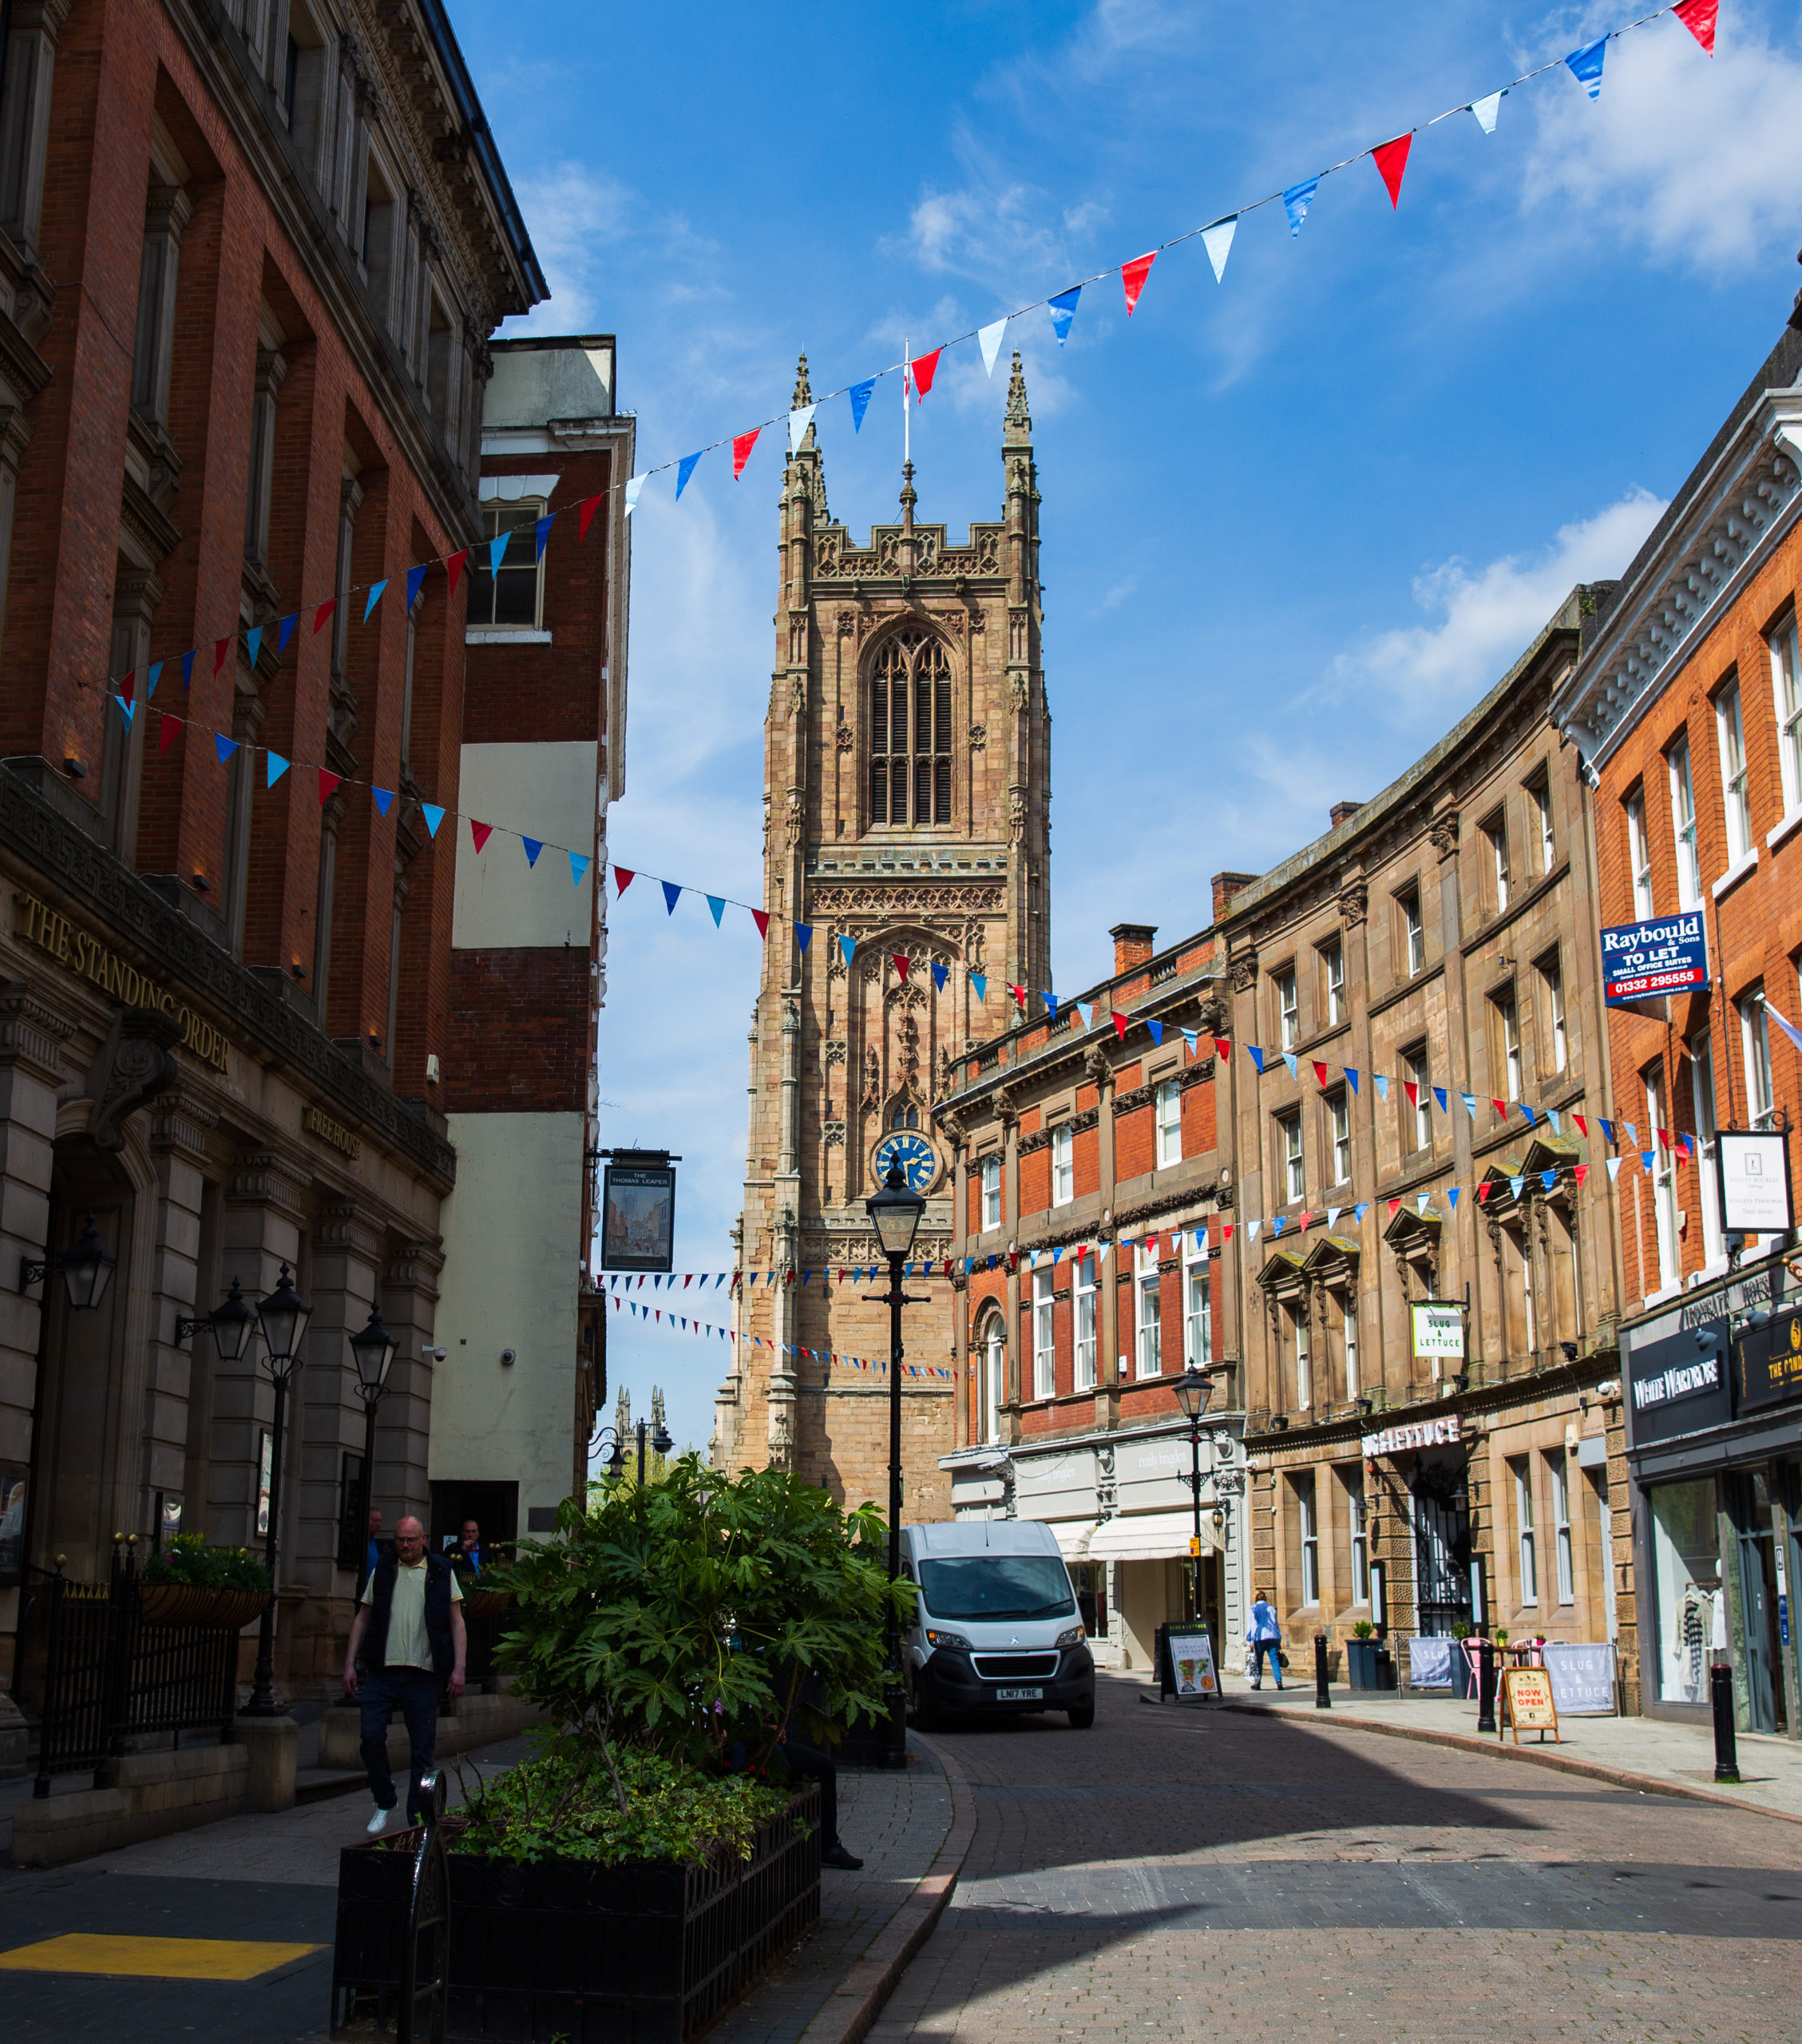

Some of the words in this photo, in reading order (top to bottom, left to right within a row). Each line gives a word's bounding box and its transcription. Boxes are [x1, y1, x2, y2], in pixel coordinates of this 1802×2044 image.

[1603, 917, 1700, 952] Raybould
[1678, 936, 1701, 945] Sons
[1622, 953, 1645, 966] TO
[1649, 946, 1679, 961] LET
[1612, 967, 1636, 976] SMALL
[1637, 961, 1663, 972] OFFICE
[1665, 957, 1693, 967] SUITES
[26, 893, 71, 962] THE
[178, 1006, 230, 1075] ORDER
[1615, 979, 1647, 993] 01332
[1650, 971, 1694, 988] 295555
[311, 1107, 332, 1143] FREE
[1428, 1319, 1450, 1328] SLUG
[1420, 1337, 1459, 1347] LETTUCE
[1768, 1361, 1783, 1380] THE
[1634, 1377, 1665, 1409] WHITE
[1663, 1359, 1718, 1400] WARDROBE
[1388, 1419, 1460, 1452] LETTUCE
[1139, 1452, 1157, 1470] emily
[1158, 1448, 1186, 1468] brigden
[1560, 1659, 1594, 1671] SLUG
[1574, 1674, 1582, 1684] &
[1000, 1689, 1020, 1698] LN17
[1021, 1689, 1037, 1697] YRE
[1552, 1686, 1609, 1699] LETTUCE
